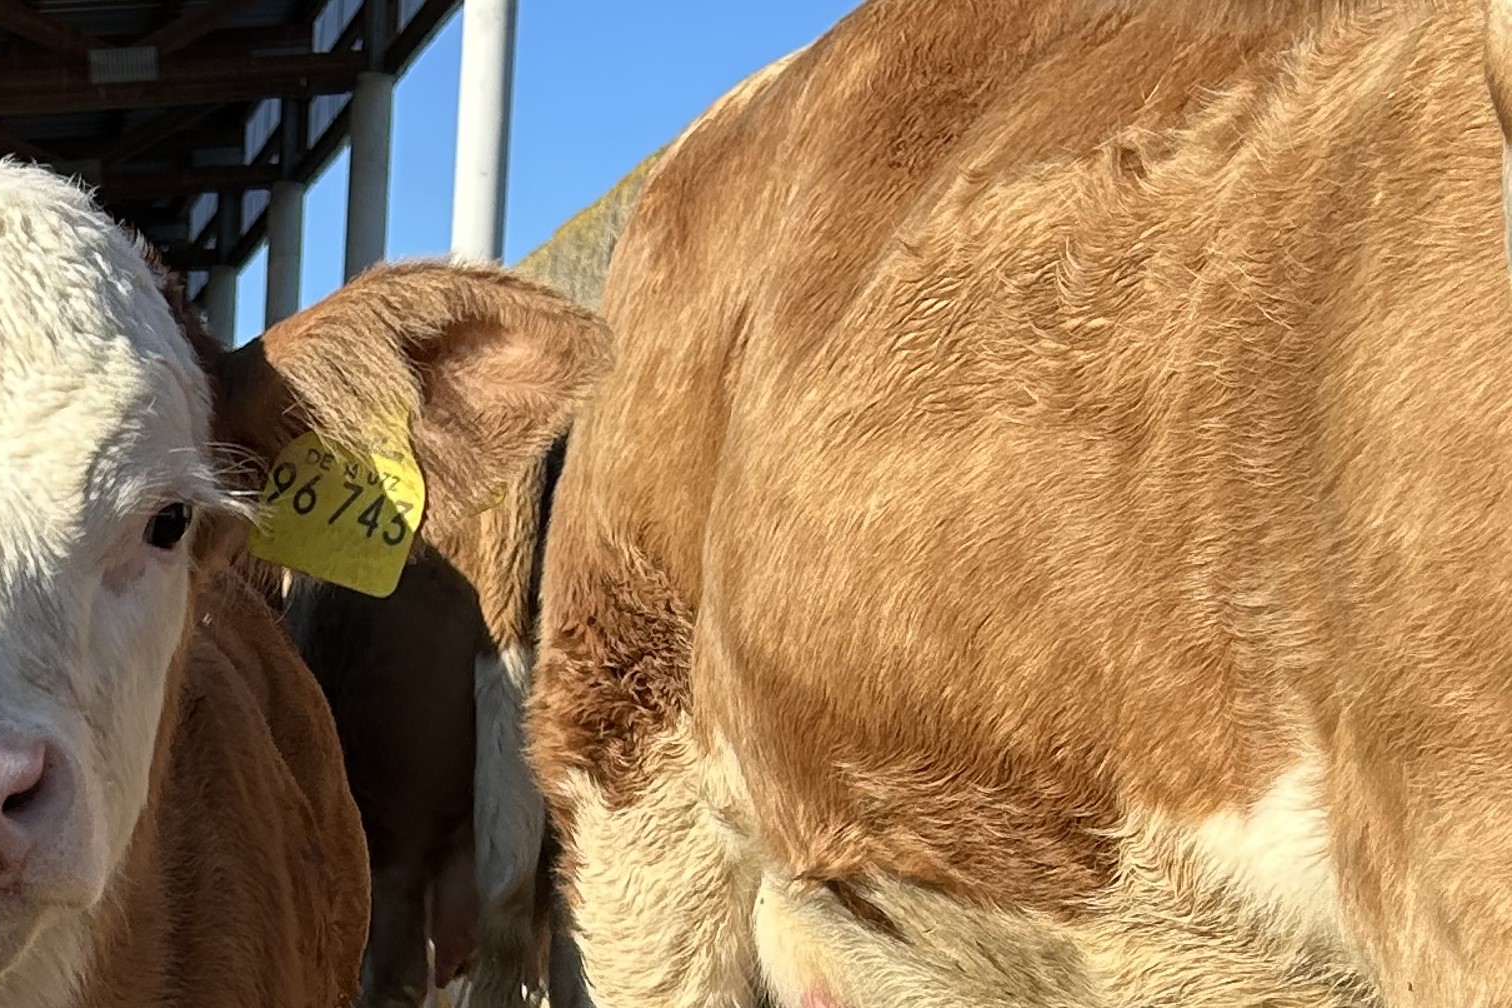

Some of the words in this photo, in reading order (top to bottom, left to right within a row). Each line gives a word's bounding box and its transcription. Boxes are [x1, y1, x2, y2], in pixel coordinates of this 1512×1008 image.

[307, 448, 335, 472] DE
[266, 462, 322, 516] 96
[327, 481, 414, 547] 743
